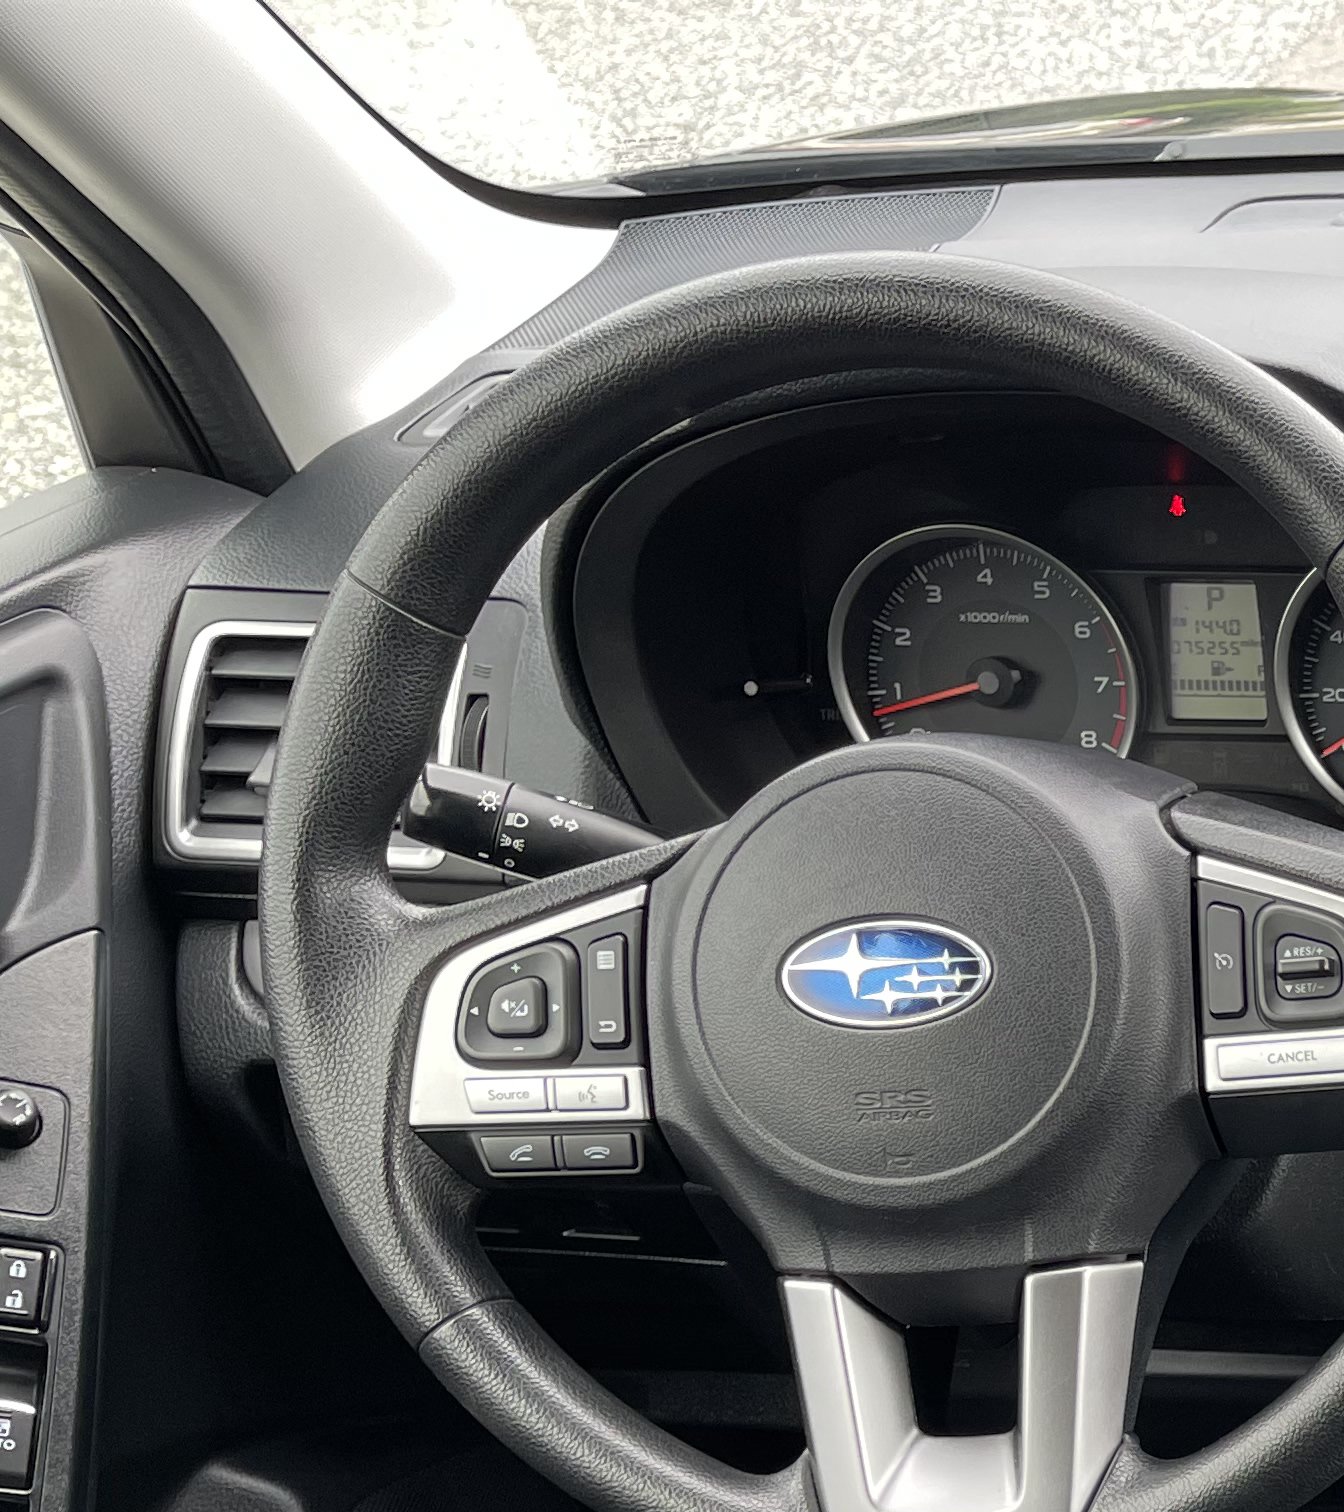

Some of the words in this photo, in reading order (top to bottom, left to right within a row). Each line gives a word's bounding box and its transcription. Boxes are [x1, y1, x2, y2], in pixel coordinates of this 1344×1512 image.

[976, 568, 993, 586] 4
[925, 584, 942, 603] 3
[1033, 581, 1050, 599] 5
[1206, 586, 1225, 612] P
[894, 628, 912, 646] 2
[1074, 621, 1091, 639] 6
[893, 682, 902, 700] 1
[1094, 676, 1109, 694] 7
[820, 709, 841, 721] TRI
[1080, 730, 1097, 749] 8
[1267, 1049, 1318, 1065] CANCEL
[487, 1089, 530, 1102] Source
[855, 1088, 932, 1108] SRS
[857, 1109, 935, 1122] AIRBAG
